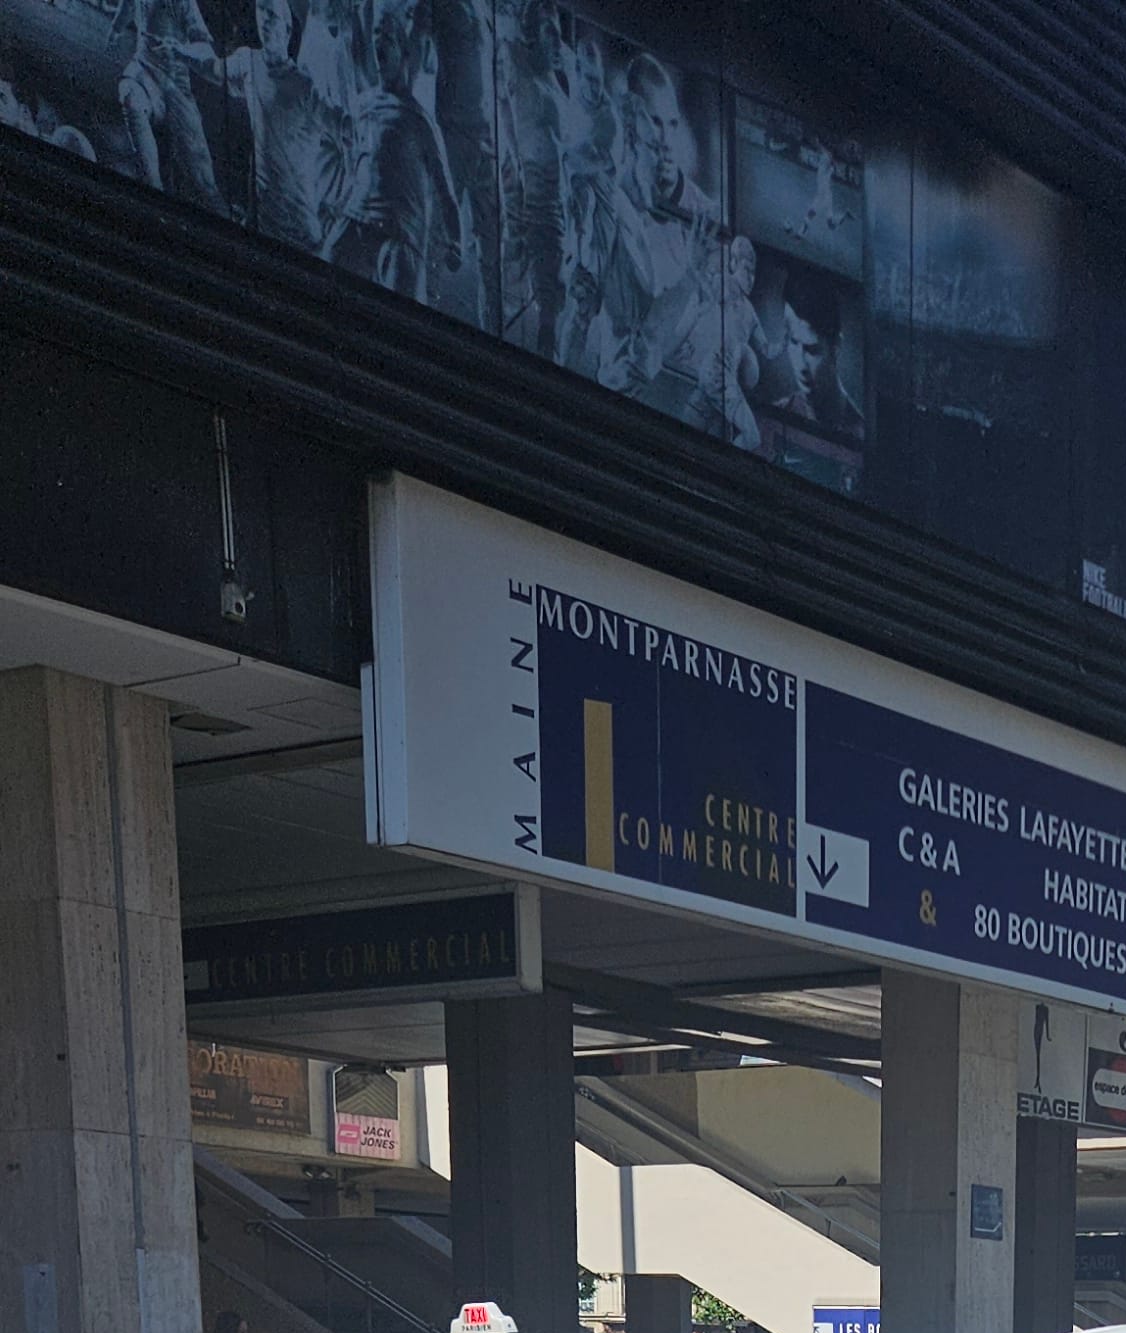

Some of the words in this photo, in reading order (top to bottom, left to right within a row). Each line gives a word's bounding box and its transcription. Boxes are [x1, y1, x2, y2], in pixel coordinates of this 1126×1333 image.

[538, 587, 797, 711] MONTPARNASSE
[508, 577, 538, 856] MAINE
[704, 793, 796, 849] CENTRE
[899, 767, 1010, 833] GALERIES
[618, 811, 796, 888] COMMERCIAL
[918, 888, 938, 927] &
[974, 903, 1000, 942] 80
[212, 949, 309, 988] CENTRE
[325, 931, 510, 978] COMMERCIAL
[362, 1125, 392, 1138] JACK
[1017, 1093, 1080, 1121] ETAGE
[360, 1135, 396, 1150] JONES
[464, 1307, 488, 1324] TAXI
